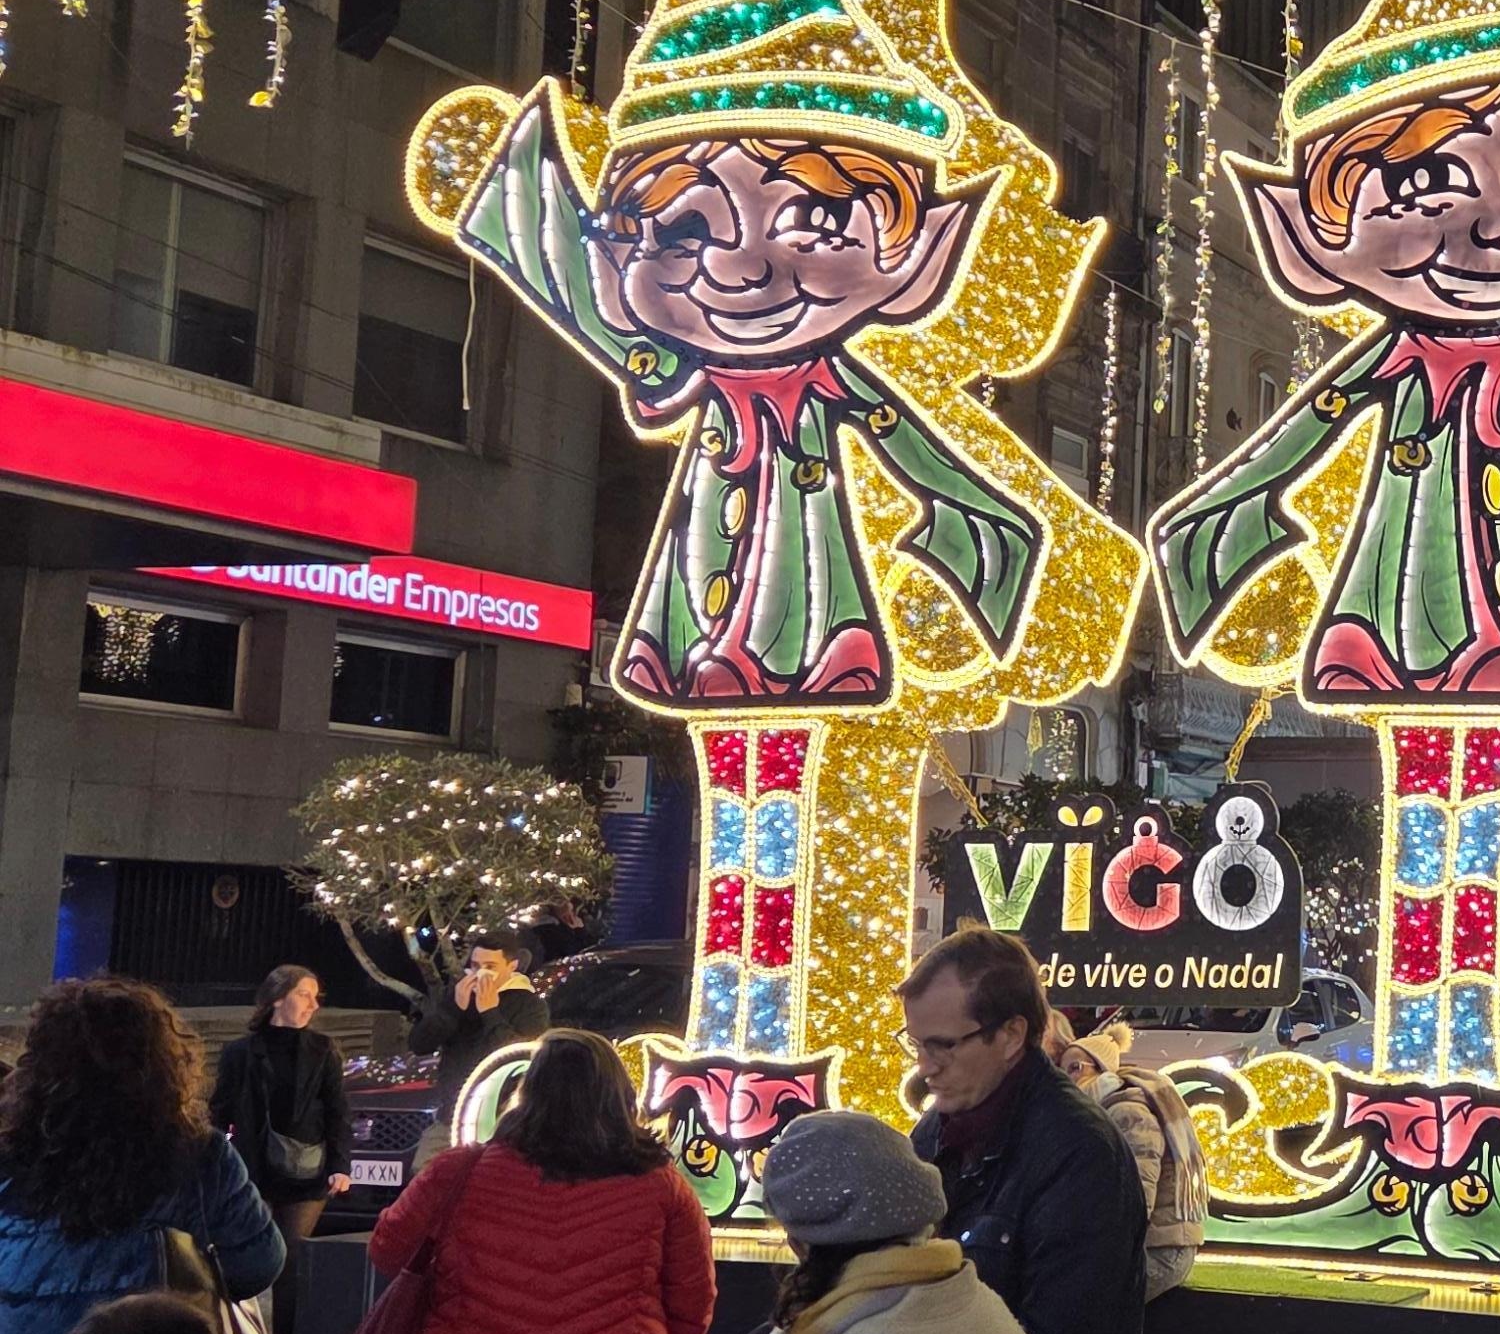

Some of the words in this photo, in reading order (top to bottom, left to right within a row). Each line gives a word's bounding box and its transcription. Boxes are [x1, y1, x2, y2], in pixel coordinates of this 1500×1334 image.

[404, 573, 540, 631] Empresas
[1038, 952, 1075, 987] de
[1083, 952, 1147, 988] vive
[1154, 962, 1174, 988] o
[1182, 952, 1284, 988] Nadal
[367, 1165, 398, 1181] KXN
